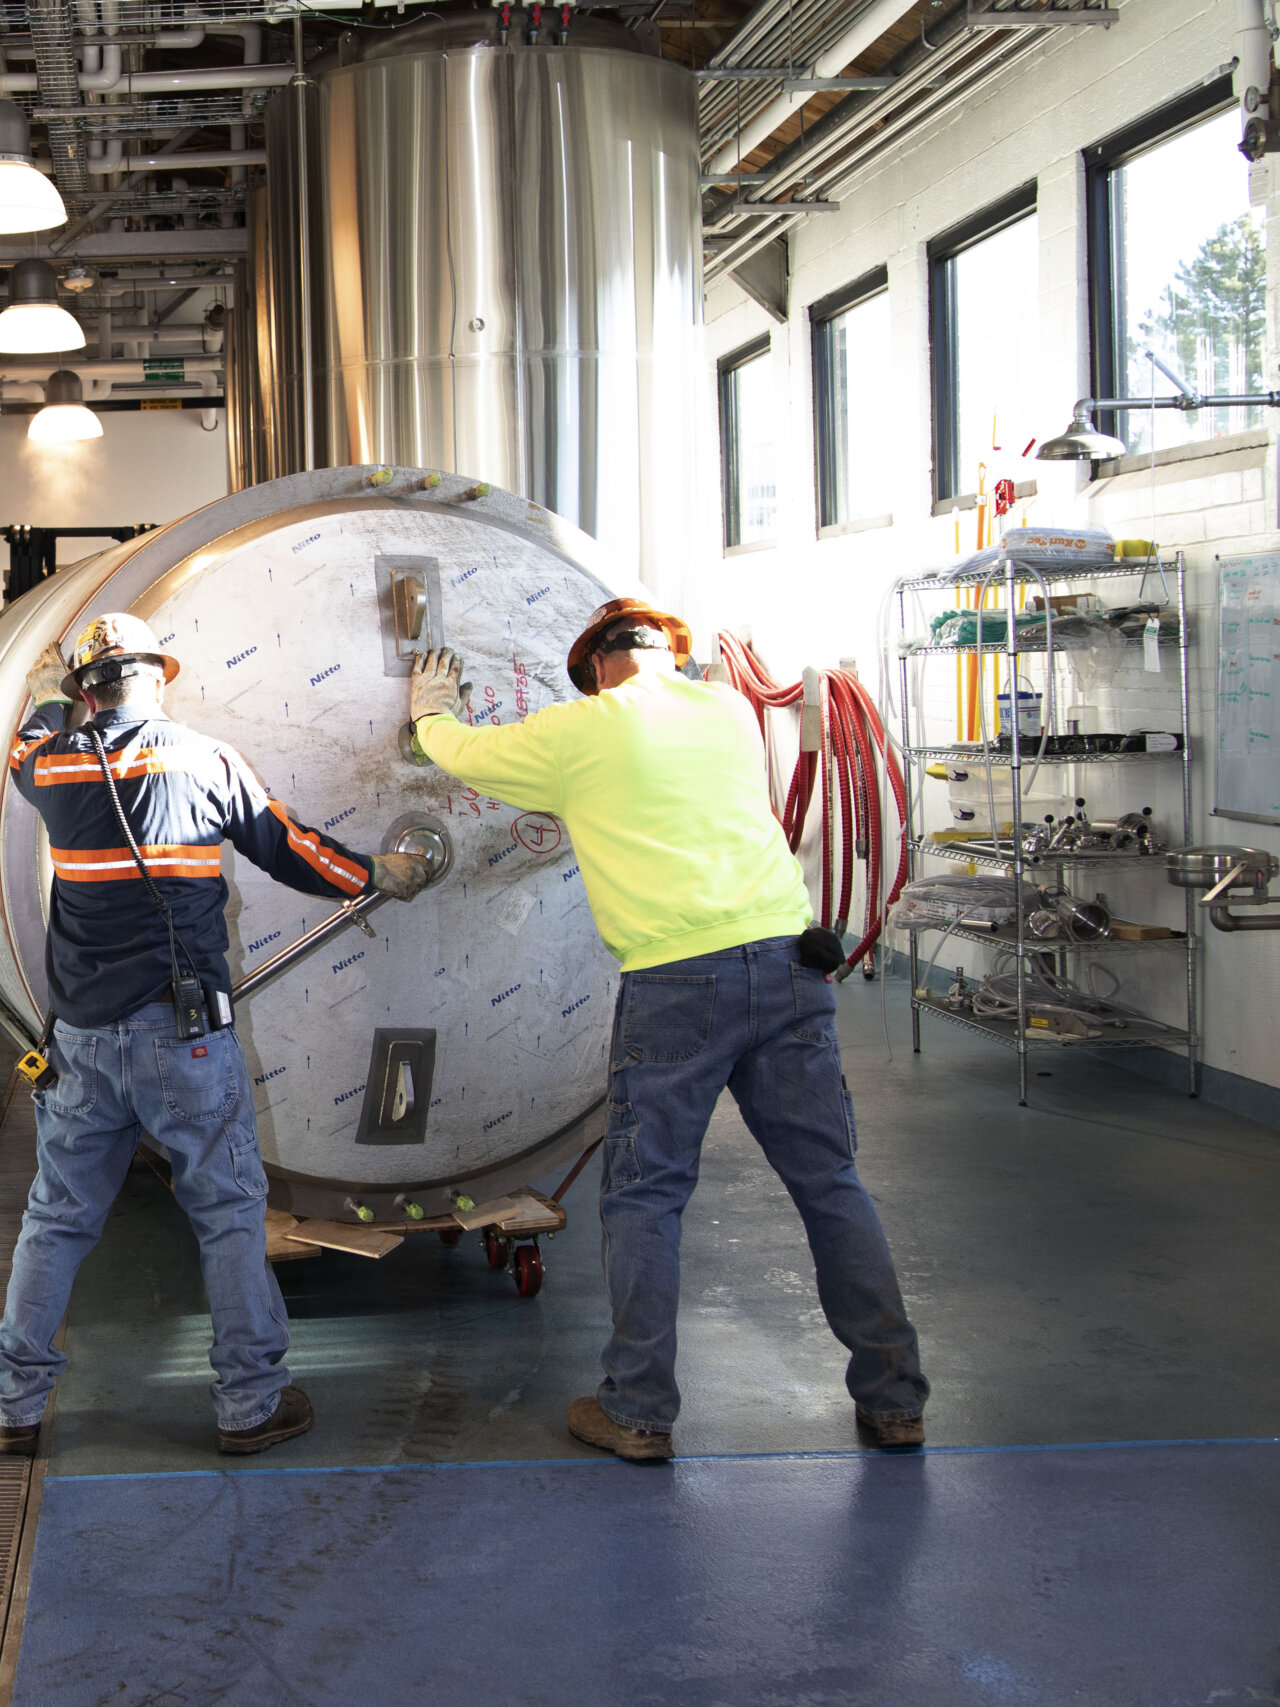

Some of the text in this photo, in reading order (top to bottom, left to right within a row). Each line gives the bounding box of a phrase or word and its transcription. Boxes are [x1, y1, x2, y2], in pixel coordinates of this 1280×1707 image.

[291, 533, 321, 554] Nitto
[450, 567, 478, 588] Nitto
[525, 586, 551, 606] Nitto
[158, 633, 176, 646] tto
[225, 645, 258, 669] Nitto
[309, 663, 341, 687] Nitto
[474, 701, 503, 724] Nitto
[323, 806, 357, 831] Nitto
[488, 843, 518, 867] Nitto
[562, 865, 581, 882] Nit
[247, 930, 282, 953] Nitto
[331, 951, 365, 974] Nitto
[490, 983, 521, 1007] Nitto
[561, 995, 590, 1018] Nitto
[254, 1066, 287, 1086] Nitto
[333, 1084, 366, 1106] Nitto
[482, 1111, 513, 1133] Nitto
